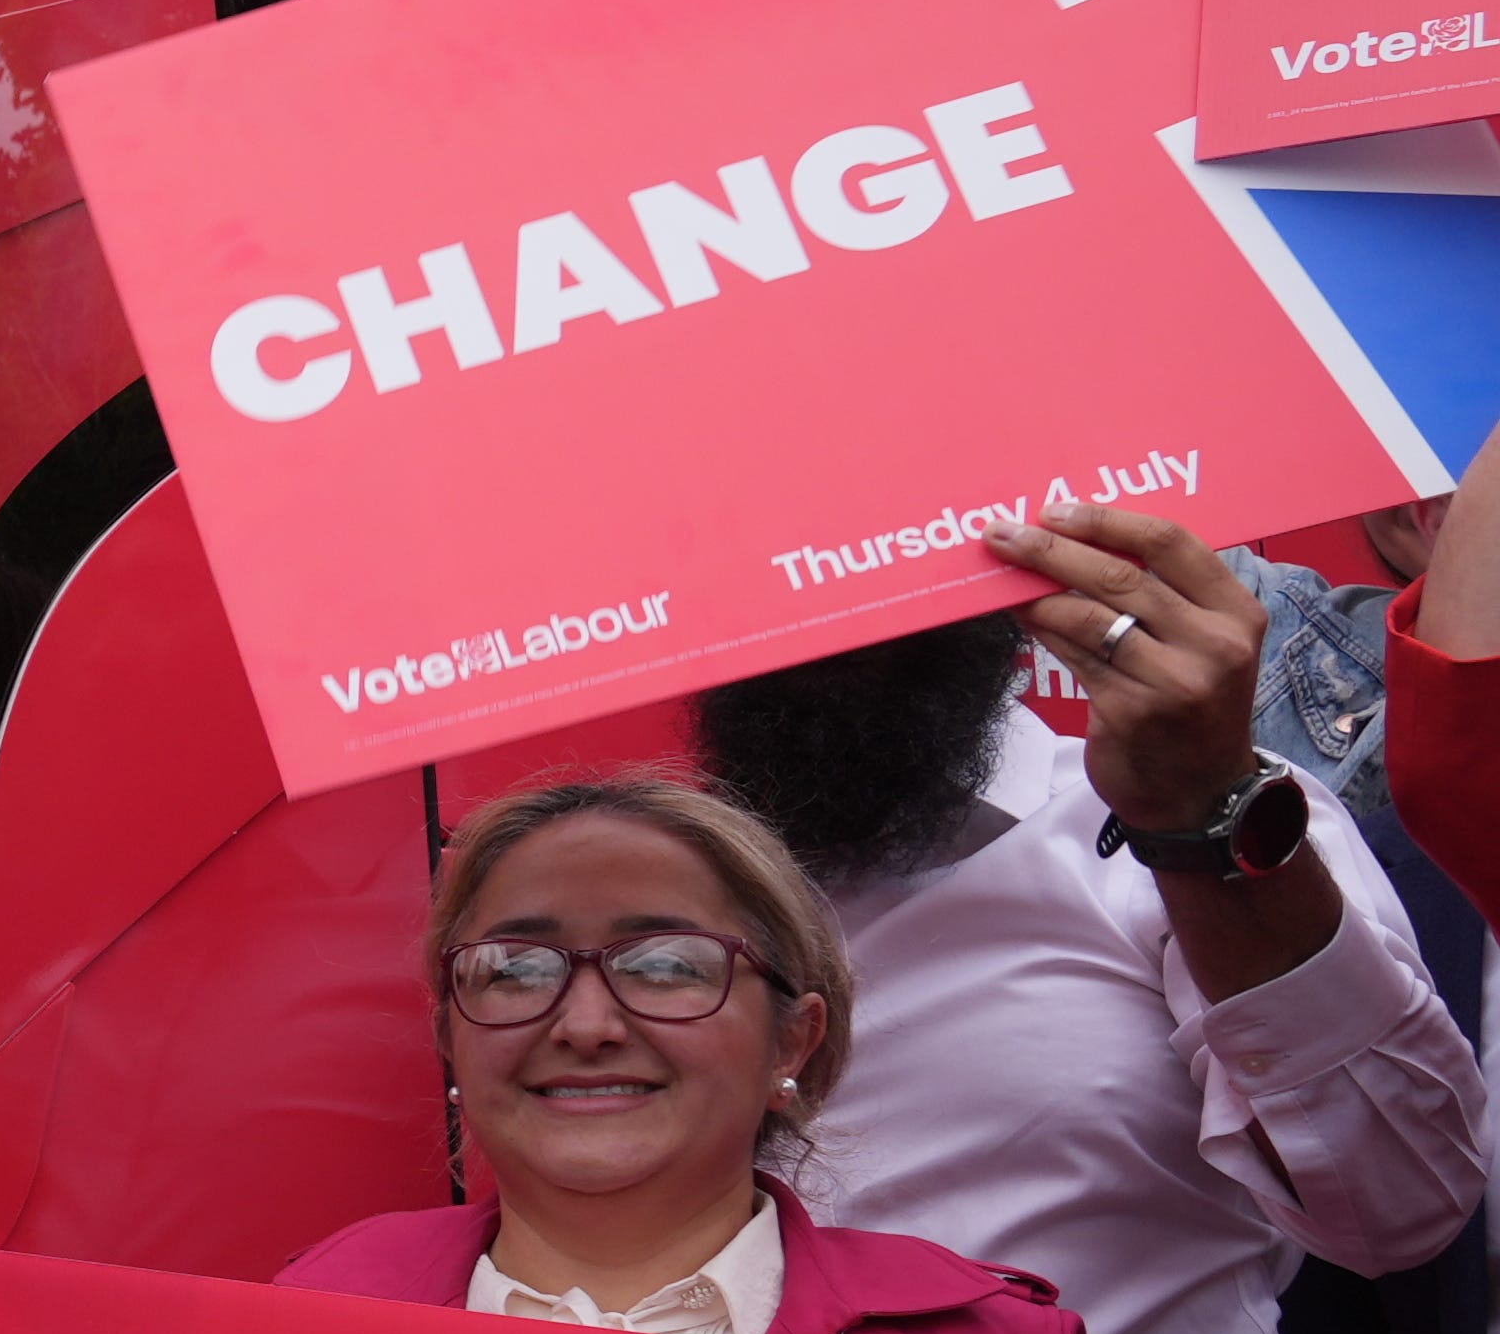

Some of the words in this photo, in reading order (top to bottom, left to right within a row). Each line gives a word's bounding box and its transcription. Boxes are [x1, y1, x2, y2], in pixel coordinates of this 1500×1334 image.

[1271, 32, 1416, 80] Vote
[211, 82, 1074, 421] CHANGE
[1091, 450, 1197, 503] July
[321, 652, 455, 713] Vote
[496, 591, 669, 671] Labour
